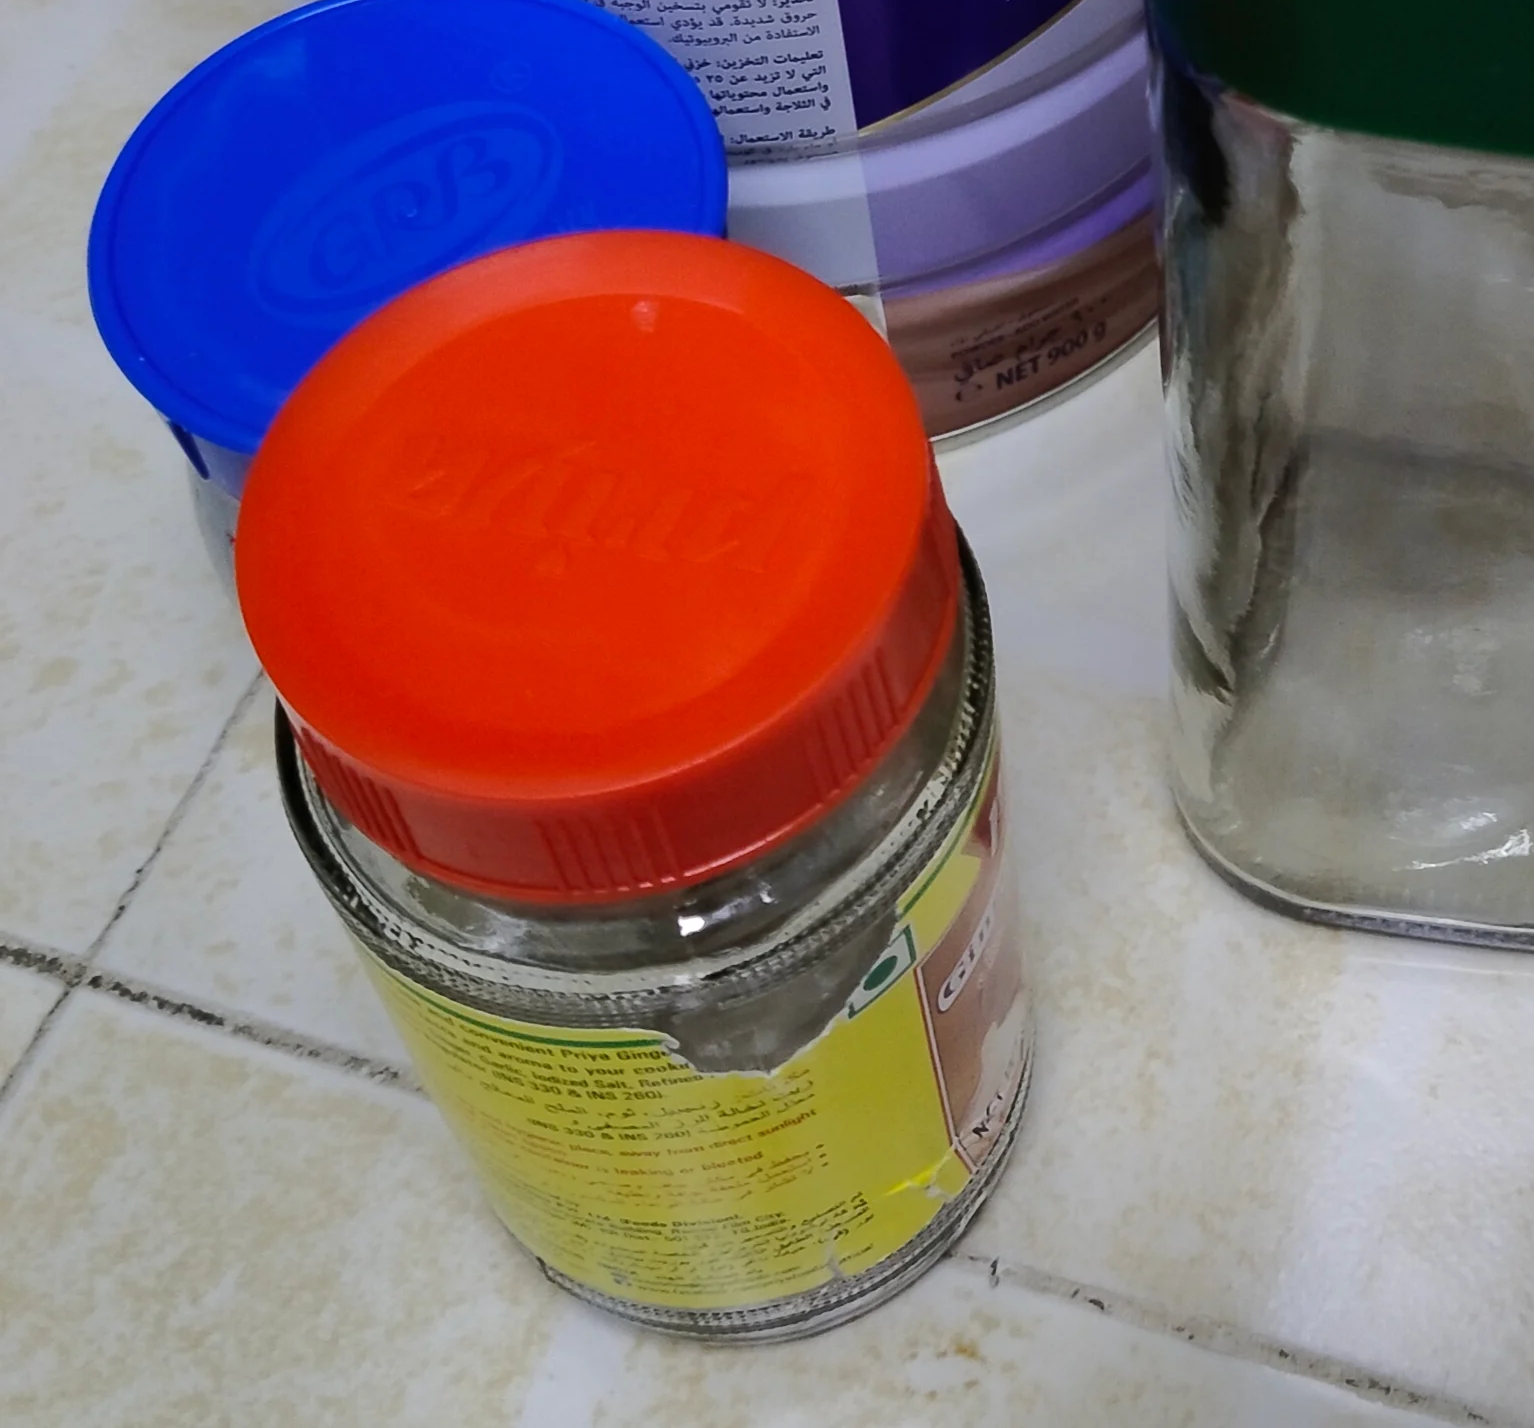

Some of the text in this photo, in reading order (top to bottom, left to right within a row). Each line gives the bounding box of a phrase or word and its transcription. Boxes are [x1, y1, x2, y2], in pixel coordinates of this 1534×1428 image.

[656, 0, 706, 14] بتسخين
[670, 13, 704, 31] يؤدي
[707, 15, 724, 28] قد
[779, 9, 819, 27] حروق
[739, 24, 821, 44] الاستفادة من
[773, 48, 825, 65] تعليمات
[706, 65, 827, 85] التي تزيد عن ٢٥
[709, 83, 829, 102] واستعمال محتوياتها
[775, 96, 832, 112] في الثلاجة
[798, 125, 836, 140] طريقة
[996, 356, 1041, 391] NET
[1047, 330, 1089, 366] 900
[1093, 320, 1107, 343] g
[459, 1023, 612, 1062] convenient Priya
[498, 1051, 554, 1071] aroma
[558, 1063, 578, 1074] to
[584, 1066, 626, 1078] your
[528, 1080, 562, 1097] 330
[585, 1089, 618, 1101] INS
[623, 1088, 665, 1102] 260)
